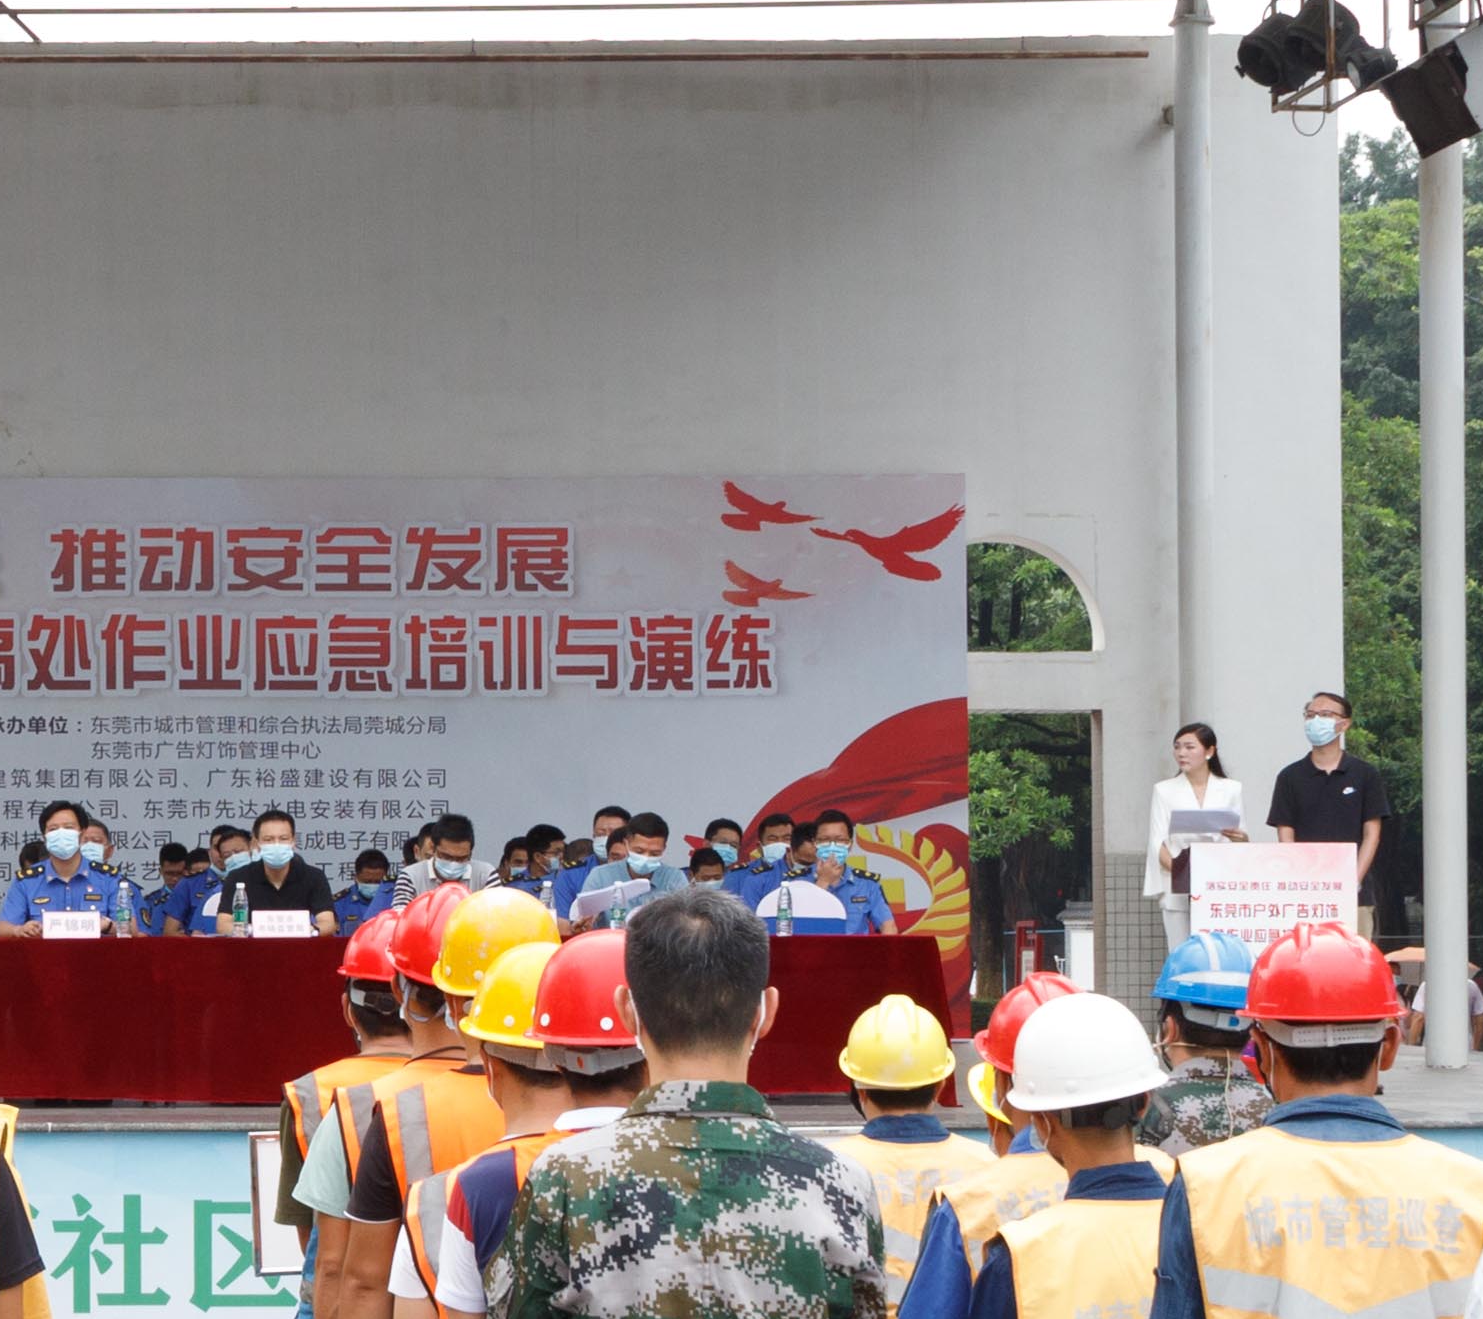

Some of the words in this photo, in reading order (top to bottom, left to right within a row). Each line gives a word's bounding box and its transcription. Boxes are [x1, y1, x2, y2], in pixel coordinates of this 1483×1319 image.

[50, 525, 572, 594] 推动安全发展
[90, 740, 322, 760] 东莞市广告灯饰管理中心
